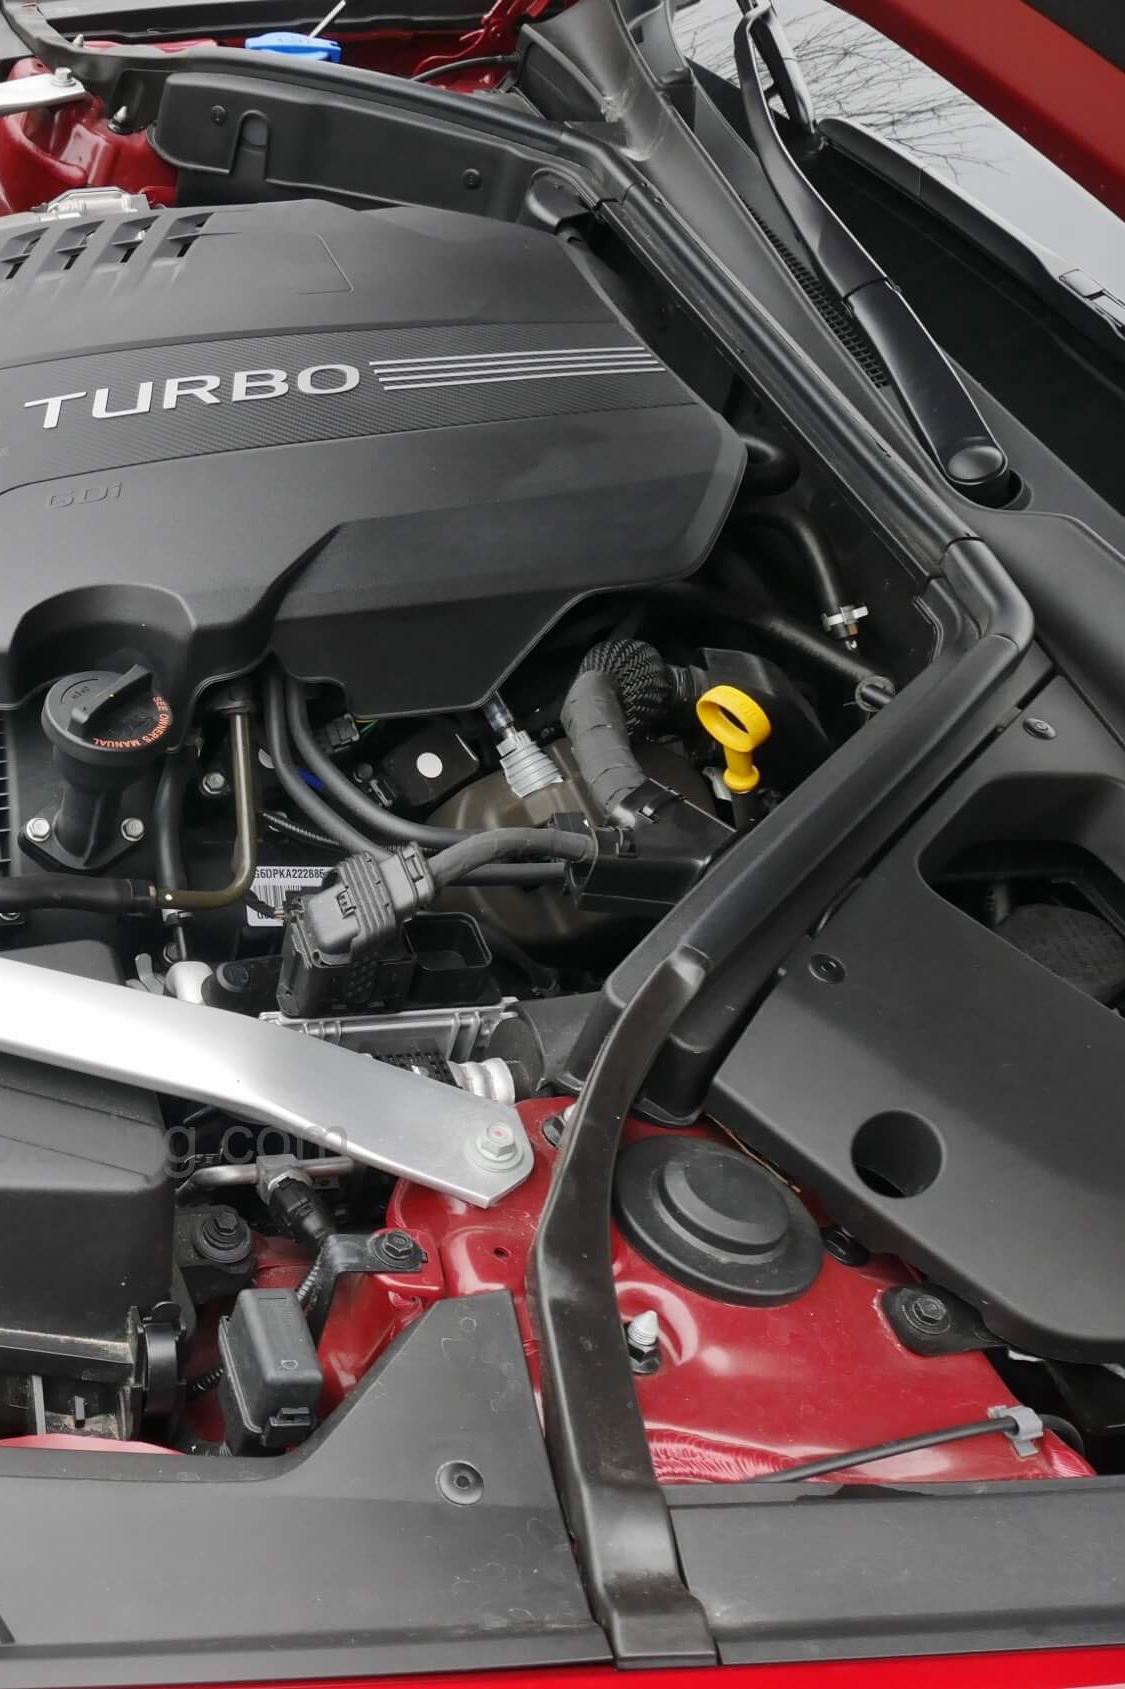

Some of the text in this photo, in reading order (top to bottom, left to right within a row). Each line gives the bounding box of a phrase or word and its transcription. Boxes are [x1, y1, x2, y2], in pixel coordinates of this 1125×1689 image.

[24, 363, 360, 429] TURBO
[92, 695, 172, 749] SEE OWNER'S MANUAL
